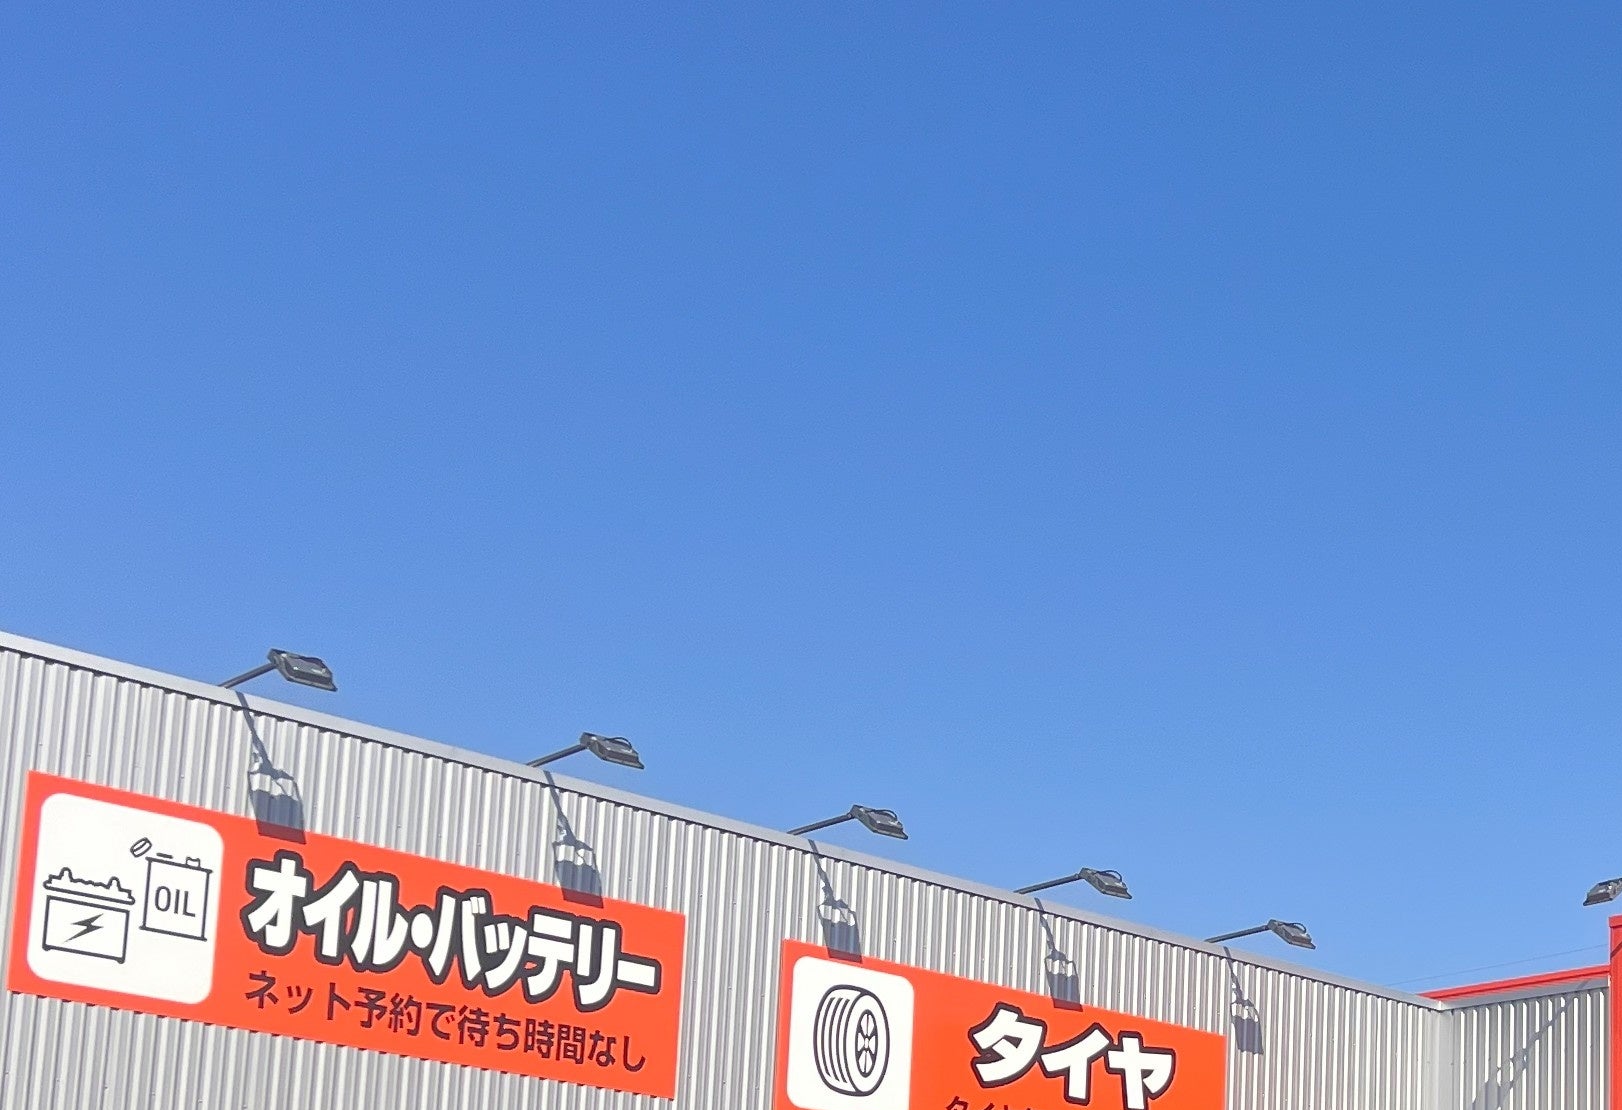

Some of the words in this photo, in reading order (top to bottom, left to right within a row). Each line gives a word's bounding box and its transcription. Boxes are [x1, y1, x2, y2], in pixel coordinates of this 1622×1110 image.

[155, 886, 196, 917] OIL
[246, 851, 661, 1011] オイル・バッテリー
[244, 969, 647, 1073] ネット予約で待ち時間なし
